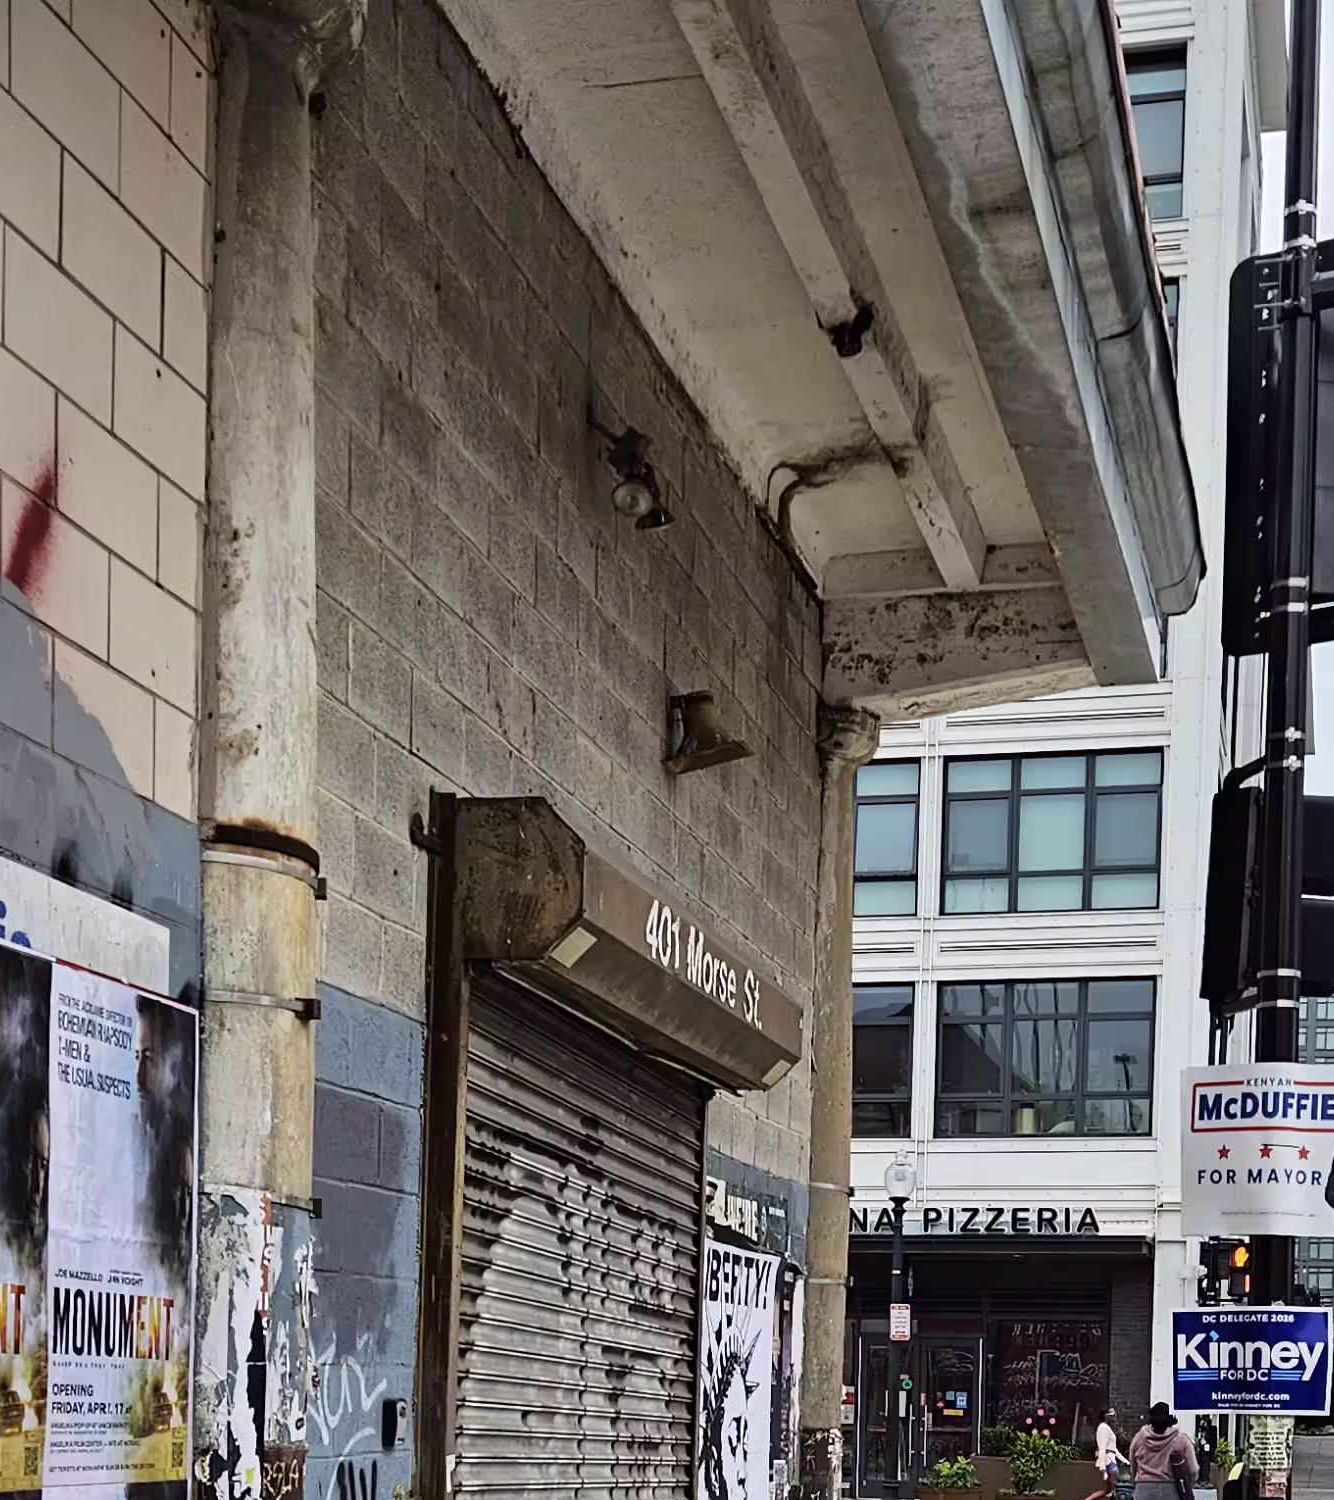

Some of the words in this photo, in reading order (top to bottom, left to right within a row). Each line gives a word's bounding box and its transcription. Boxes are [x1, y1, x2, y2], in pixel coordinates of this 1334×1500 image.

[646, 899, 681, 970] 401
[687, 925, 737, 1009] Morse
[743, 969, 763, 1031] St.
[1246, 1078, 1293, 1087] KENYAN
[1198, 1168, 1237, 1185] FOR
[1247, 1168, 1322, 1186] MAYOR
[923, 1207, 1101, 1234] PIZZERIA
[53, 1286, 175, 1361] MONUMENT
[1202, 1315, 1216, 1323] DC
[1220, 1314, 1268, 1323] DELEGATE
[1177, 1330, 1325, 1381] Kinney
[1220, 1369, 1244, 1381] FOR
[1246, 1369, 1269, 1381] DC
[52, 1383, 94, 1397] OPENING
[1212, 1391, 1290, 1401] kinneyfordc.com
